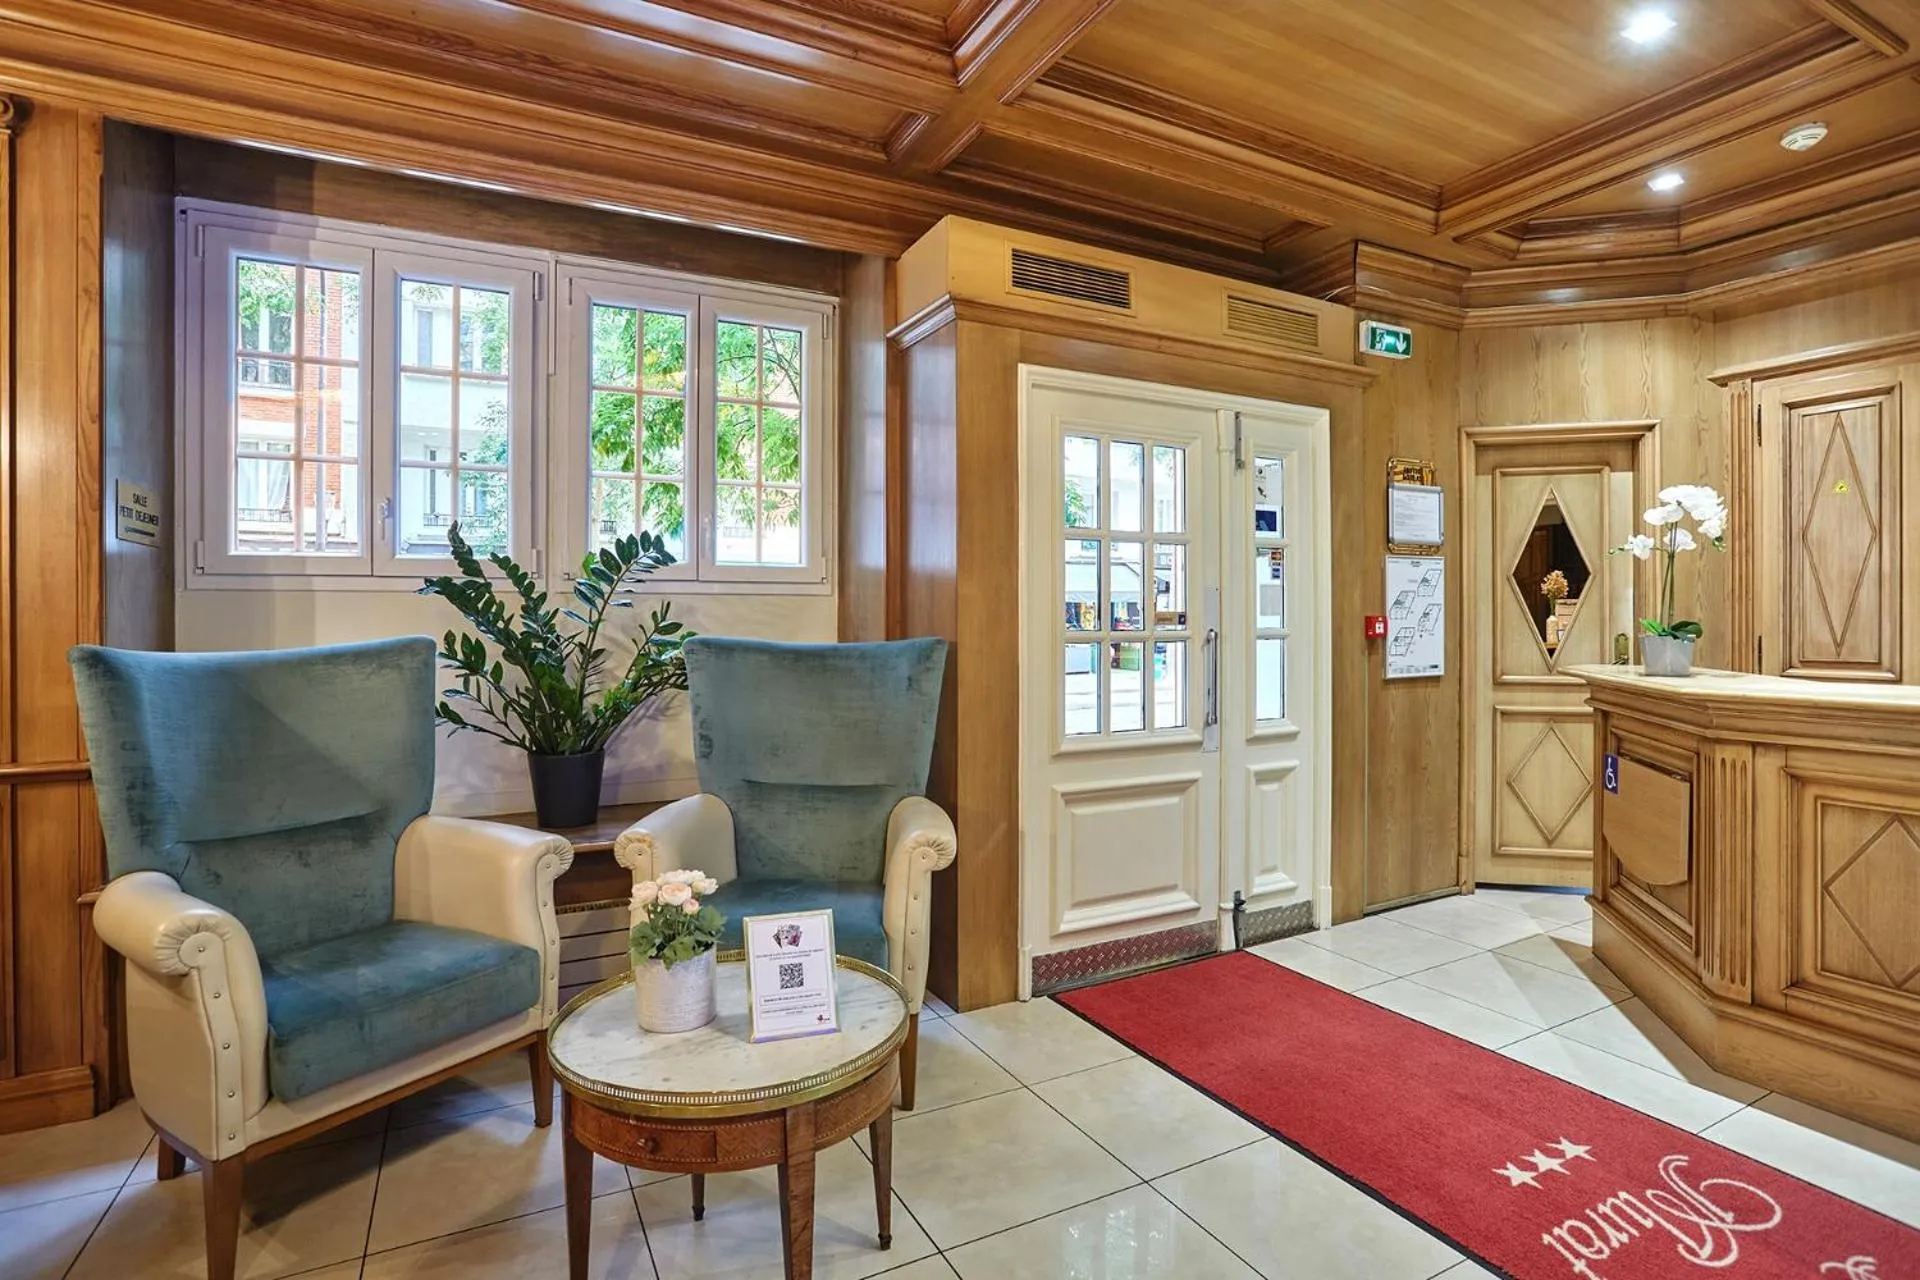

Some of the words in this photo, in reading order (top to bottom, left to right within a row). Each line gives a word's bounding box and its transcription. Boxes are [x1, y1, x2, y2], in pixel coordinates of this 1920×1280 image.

[132, 493, 148, 508] SALLE
[119, 505, 134, 519] PETIT
[1541, 1154, 1783, 1280] Murat
